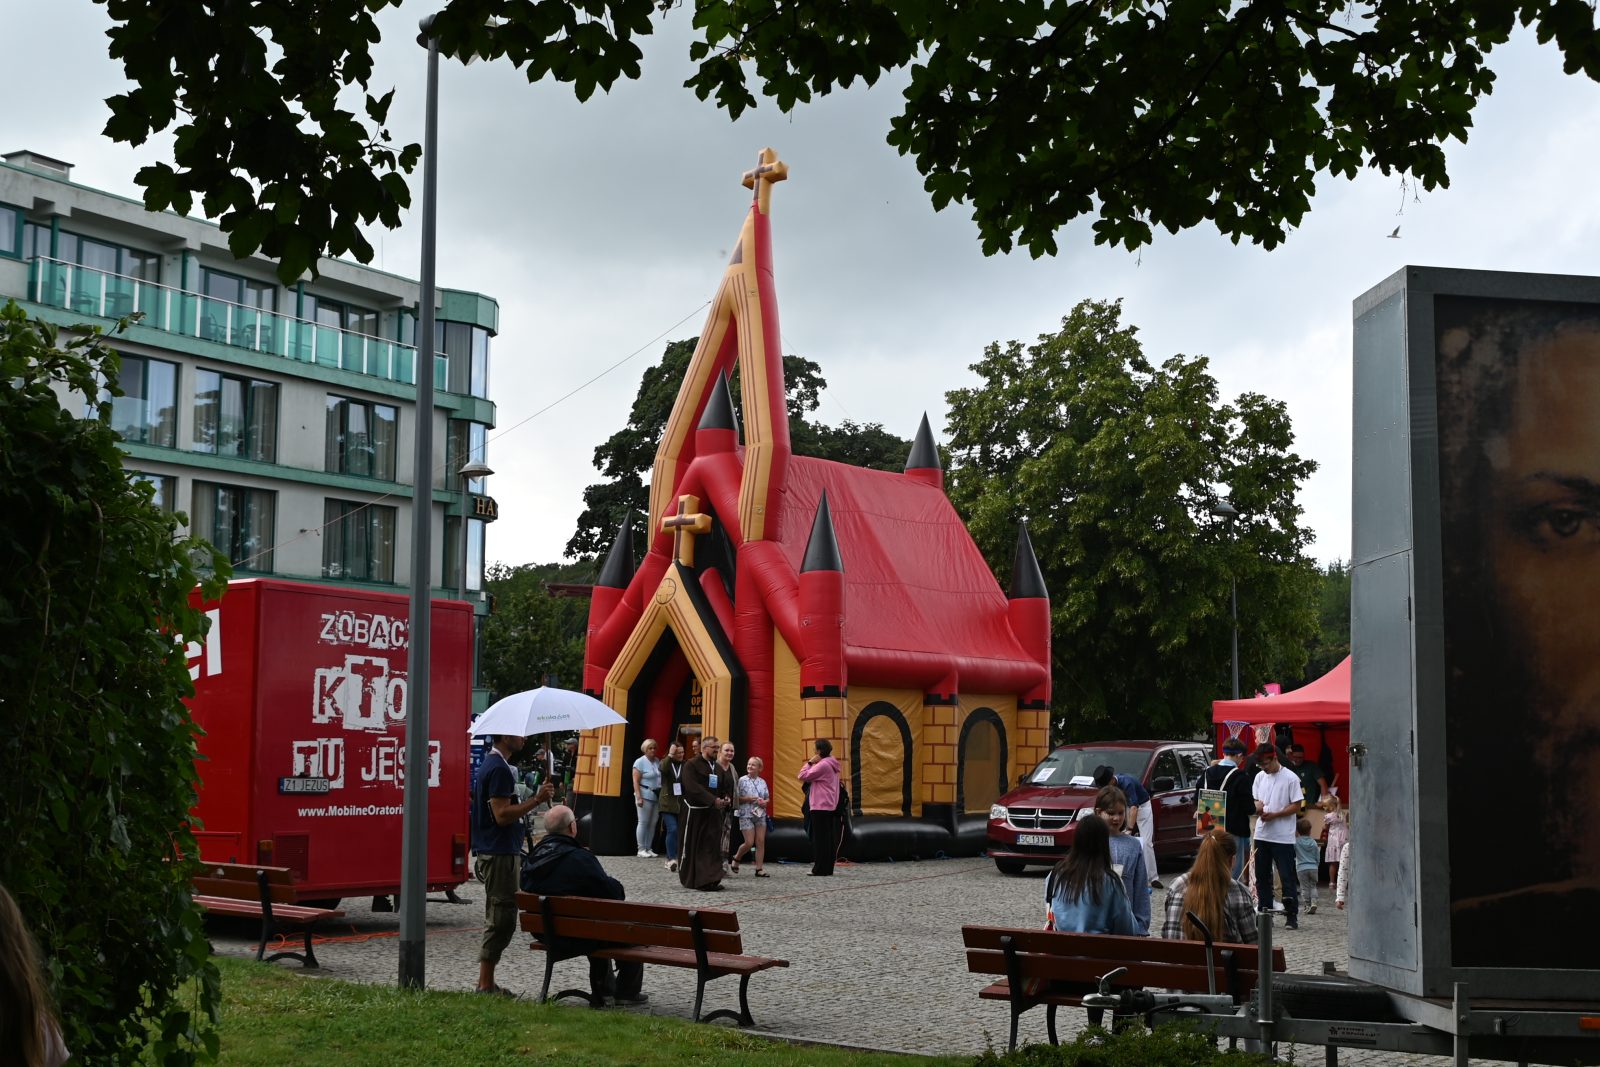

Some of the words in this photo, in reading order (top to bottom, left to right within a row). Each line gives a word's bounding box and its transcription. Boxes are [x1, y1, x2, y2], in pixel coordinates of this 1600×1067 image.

[320, 612, 410, 649] ZOBAC
[313, 654, 408, 733] KTO
[292, 738, 345, 789] TU
[285, 779, 296, 791] Z1
[300, 779, 329, 791] JEZUS
[298, 804, 404, 817] www.MobilneOratori
